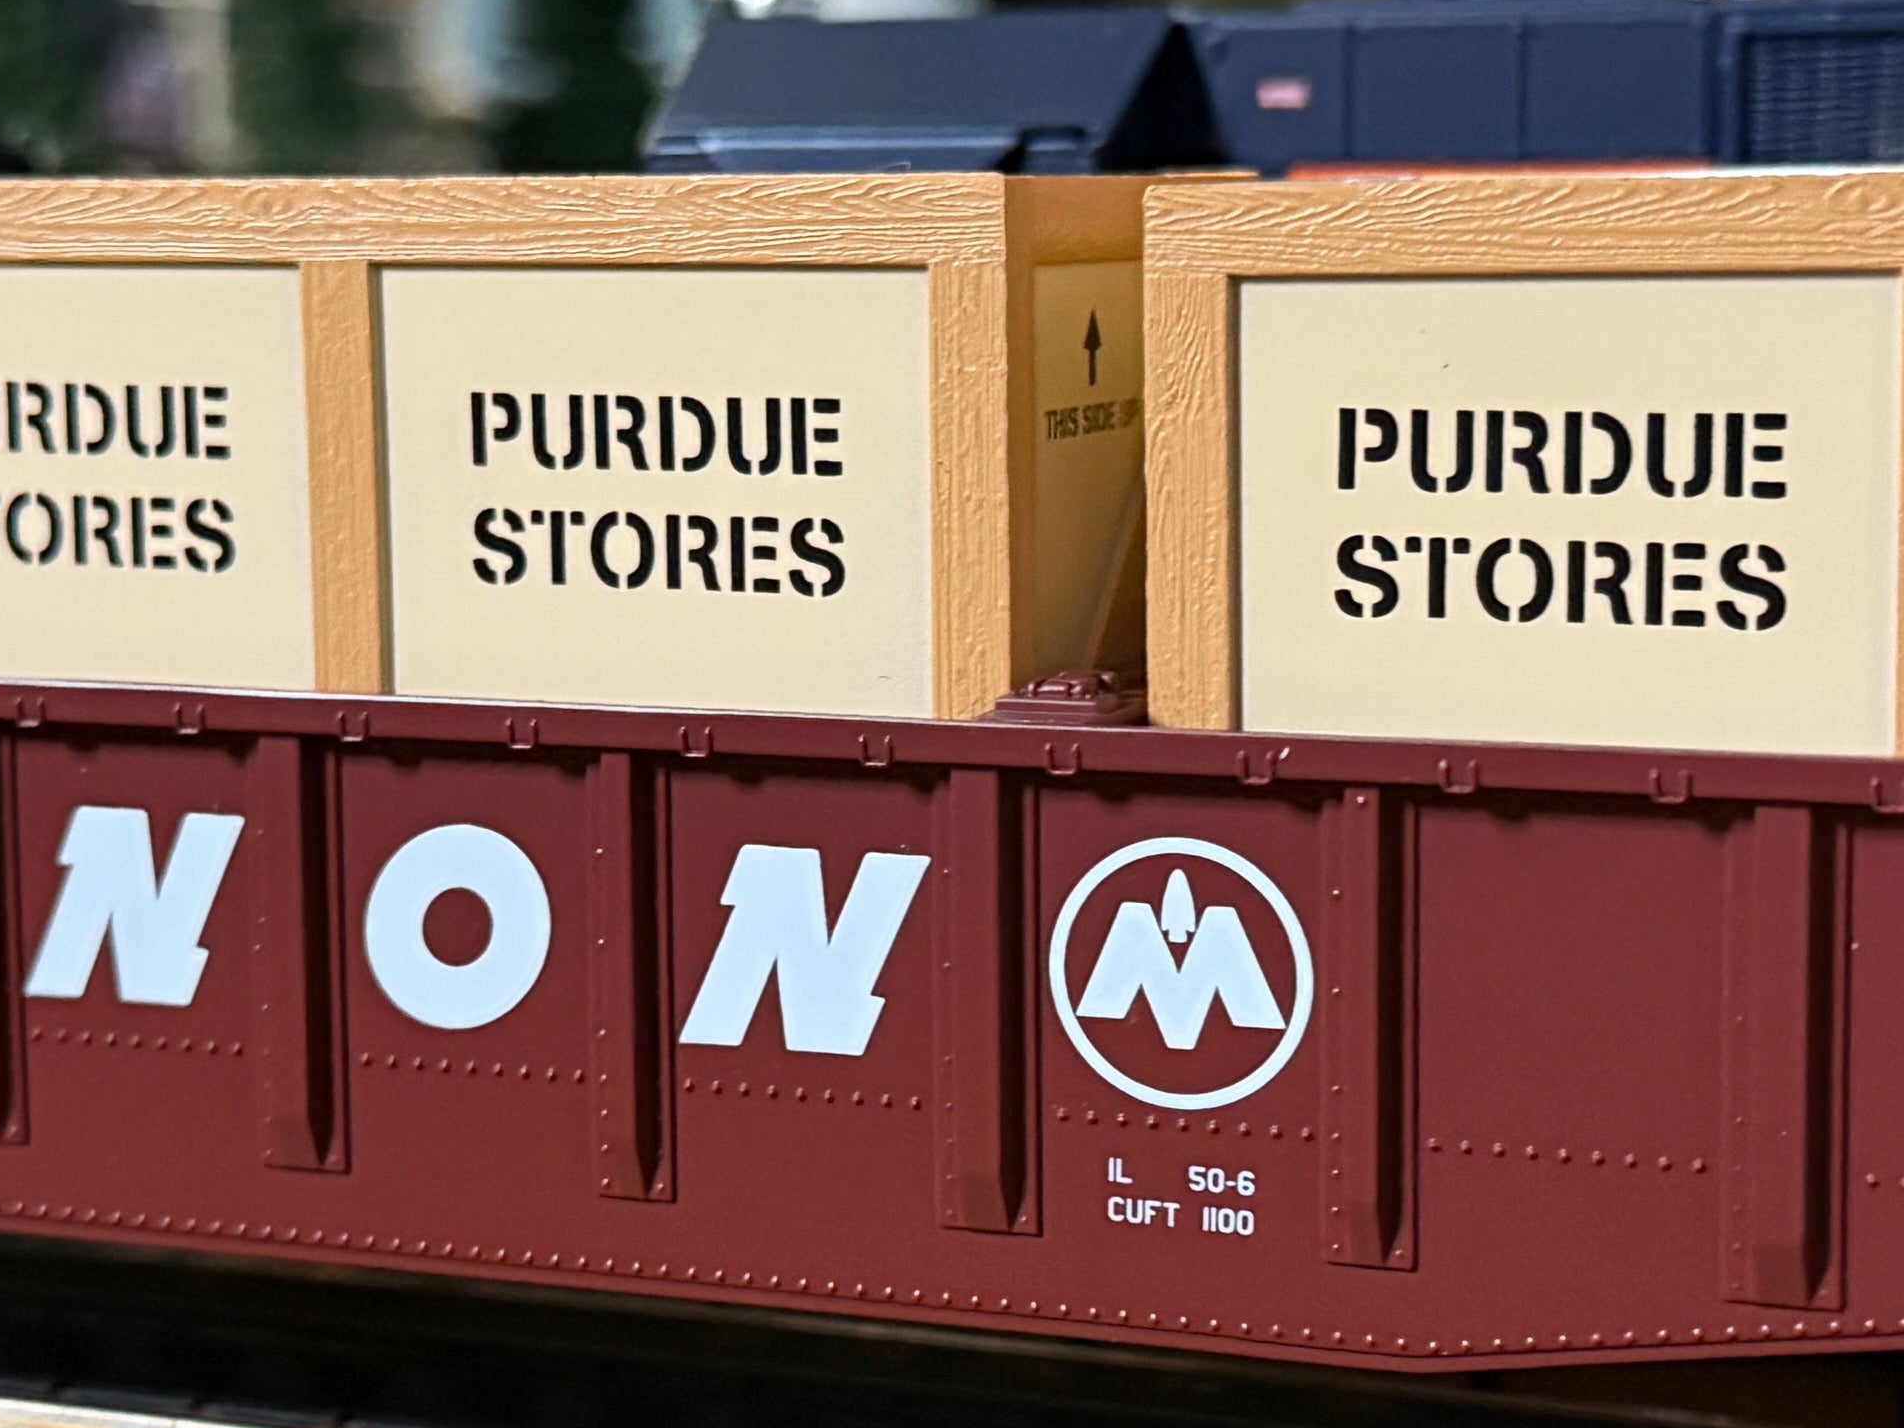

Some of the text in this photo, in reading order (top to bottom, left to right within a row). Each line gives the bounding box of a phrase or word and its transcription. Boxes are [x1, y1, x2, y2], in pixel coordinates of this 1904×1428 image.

[470, 390, 844, 478] PURDUE
[1045, 406, 1079, 440] THIS
[1336, 406, 1789, 501] PURDUE
[472, 506, 847, 598] STORES
[1332, 533, 1789, 634] STORES
[1107, 1157, 1256, 1197] IL 50-6
[1107, 1196, 1255, 1236] CUFT 1100
